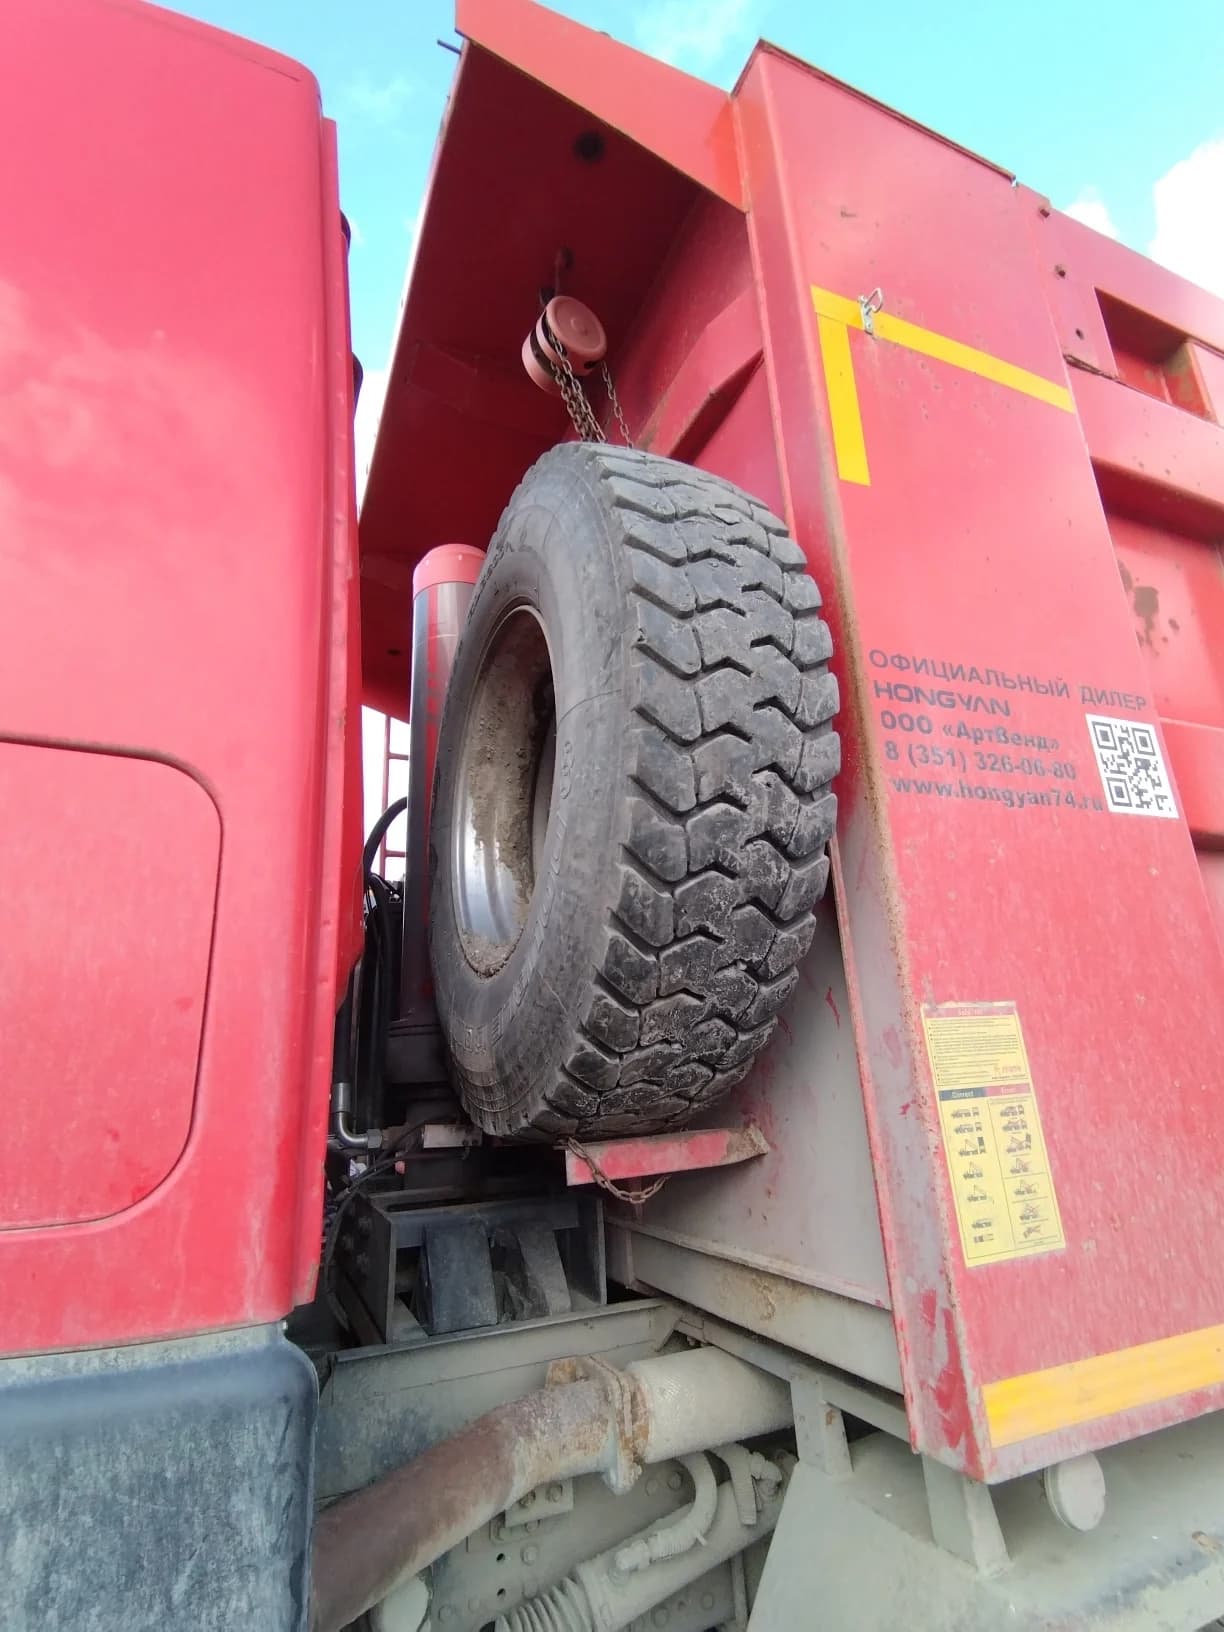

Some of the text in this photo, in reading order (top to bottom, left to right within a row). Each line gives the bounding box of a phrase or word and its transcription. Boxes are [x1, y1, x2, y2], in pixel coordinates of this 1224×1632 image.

[869, 649, 1147, 711] ОФИЦИАЛЬНЫЙ ДИЛЕР
[873, 680, 1011, 717] HONGYAN
[881, 710, 933, 734] ООО
[884, 741, 899, 761] 8
[908, 743, 967, 774] (351)
